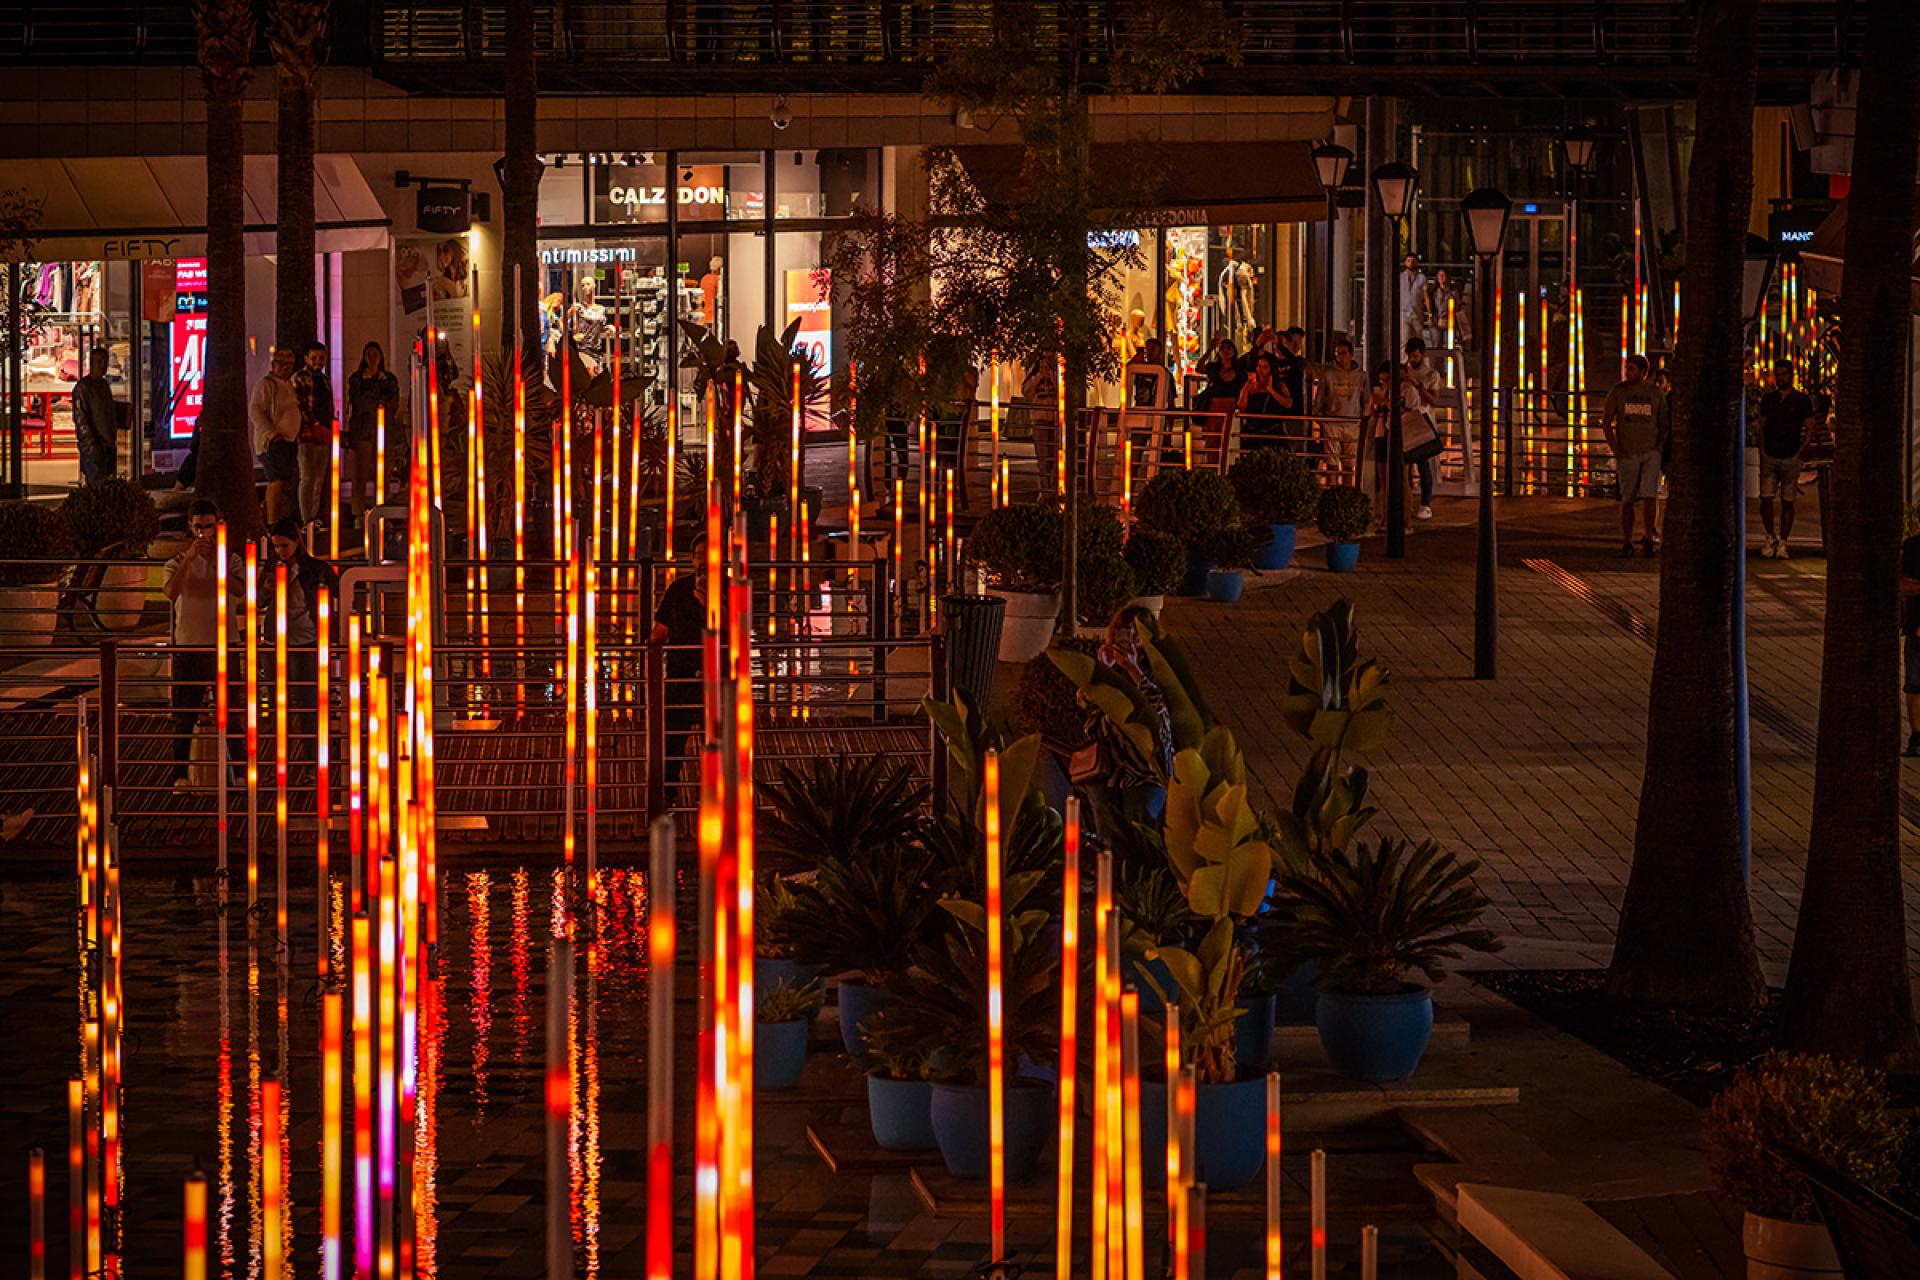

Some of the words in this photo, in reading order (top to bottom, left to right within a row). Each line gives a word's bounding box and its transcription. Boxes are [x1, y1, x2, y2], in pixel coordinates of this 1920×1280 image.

[609, 186, 725, 204] CALZDON
[423, 204, 462, 216] FIFTY
[104, 239, 180, 257] FIFTY
